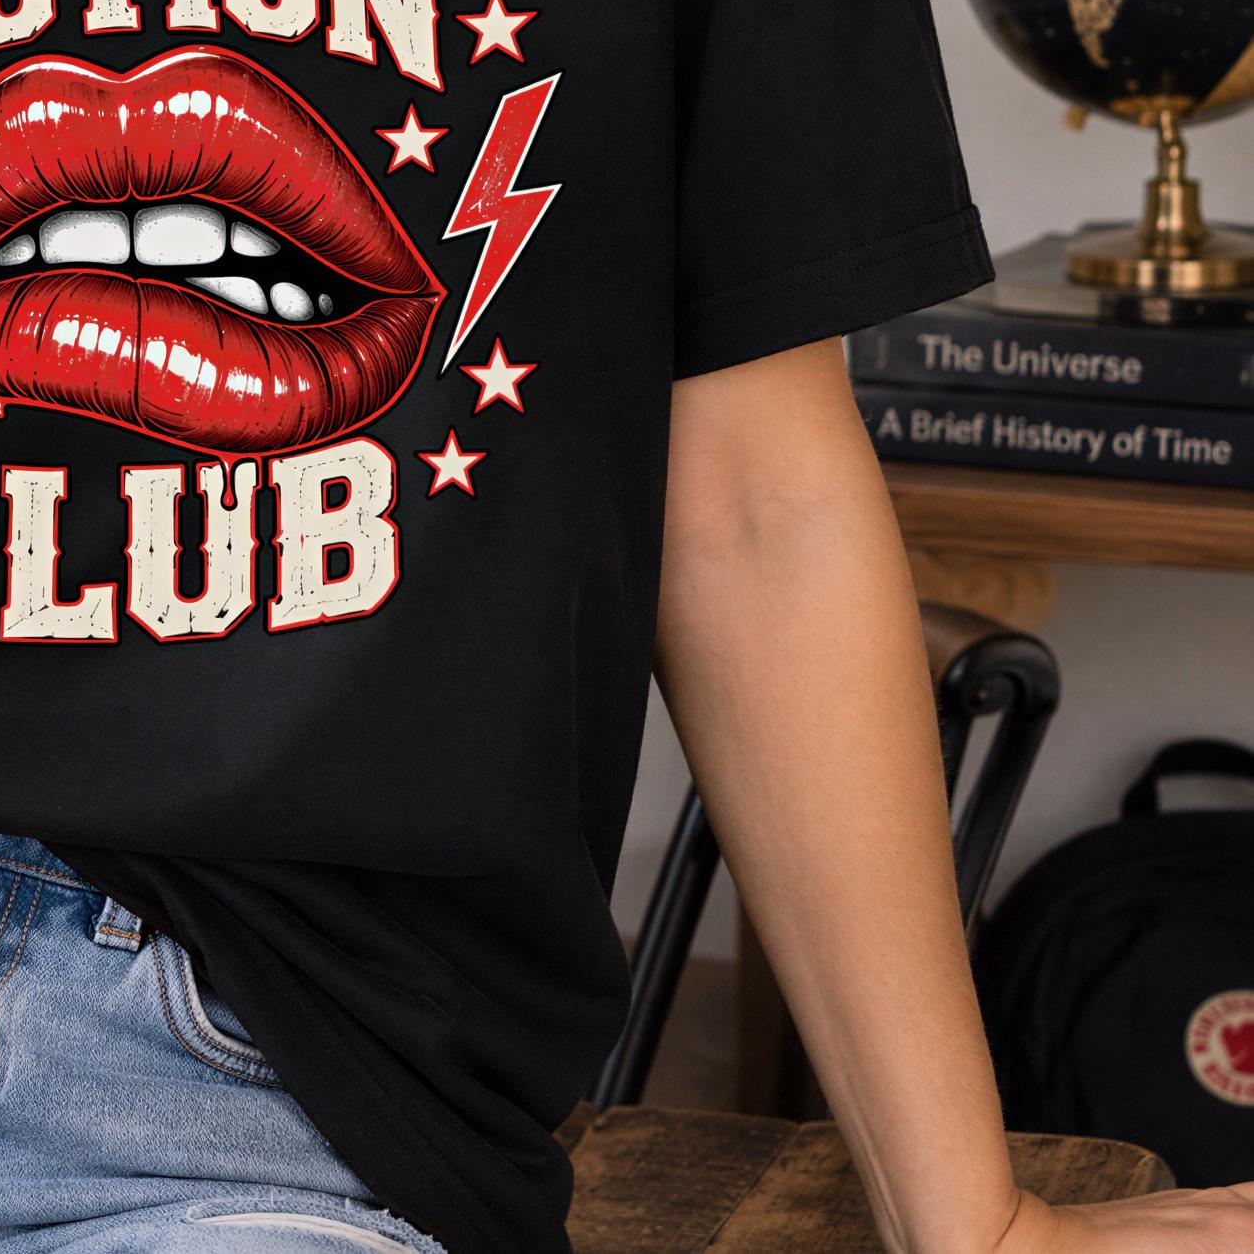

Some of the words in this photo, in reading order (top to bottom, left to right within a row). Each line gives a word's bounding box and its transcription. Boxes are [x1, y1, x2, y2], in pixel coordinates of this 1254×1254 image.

[918, 332, 984, 372] The
[992, 340, 1143, 384] Universe
[877, 407, 904, 440] A
[910, 408, 986, 444] Brief
[992, 413, 1106, 463] History
[1112, 425, 1148, 459] of
[1151, 426, 1233, 465] Time
